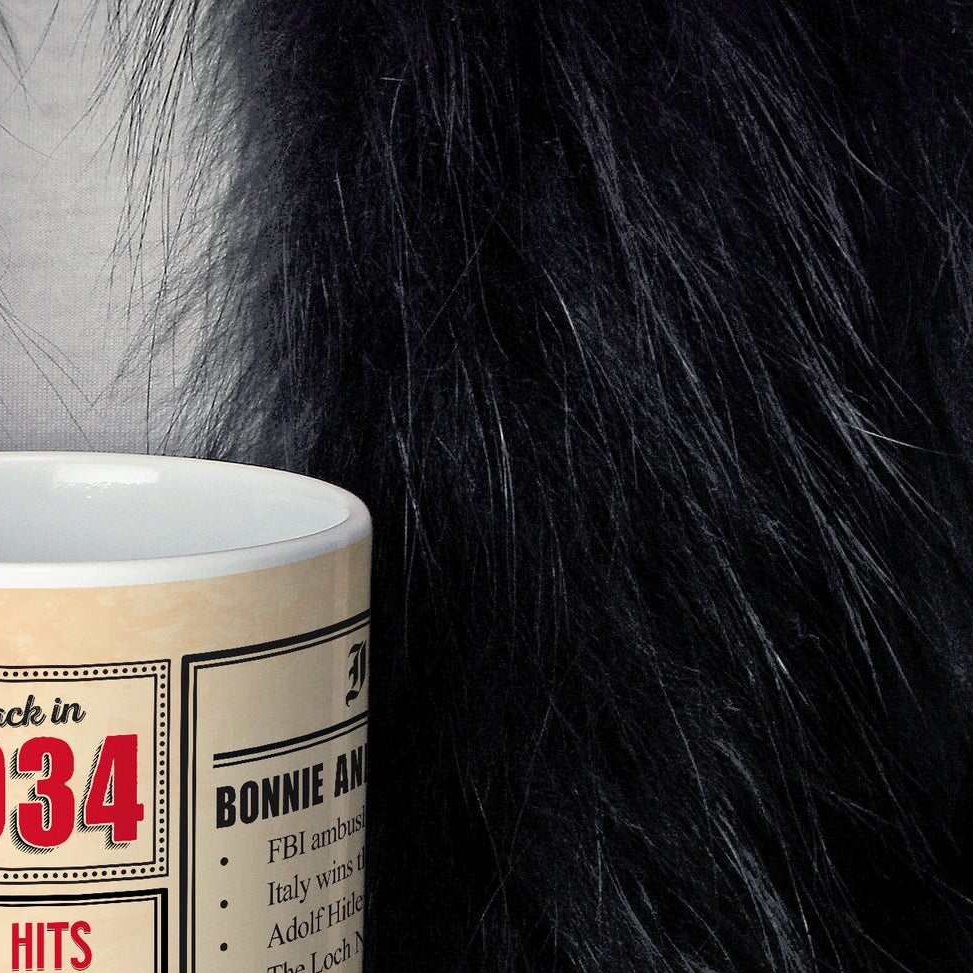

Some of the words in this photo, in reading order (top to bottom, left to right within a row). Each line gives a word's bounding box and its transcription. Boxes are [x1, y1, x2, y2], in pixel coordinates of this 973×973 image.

[50, 697, 87, 725] in
[215, 762, 324, 829] BONNIE
[266, 833, 314, 865] FBI
[266, 872, 312, 907] Italy
[316, 860, 354, 890] wins
[267, 906, 325, 949] Adolf
[327, 891, 364, 929] Hitle
[11, 920, 93, 972] HITS
